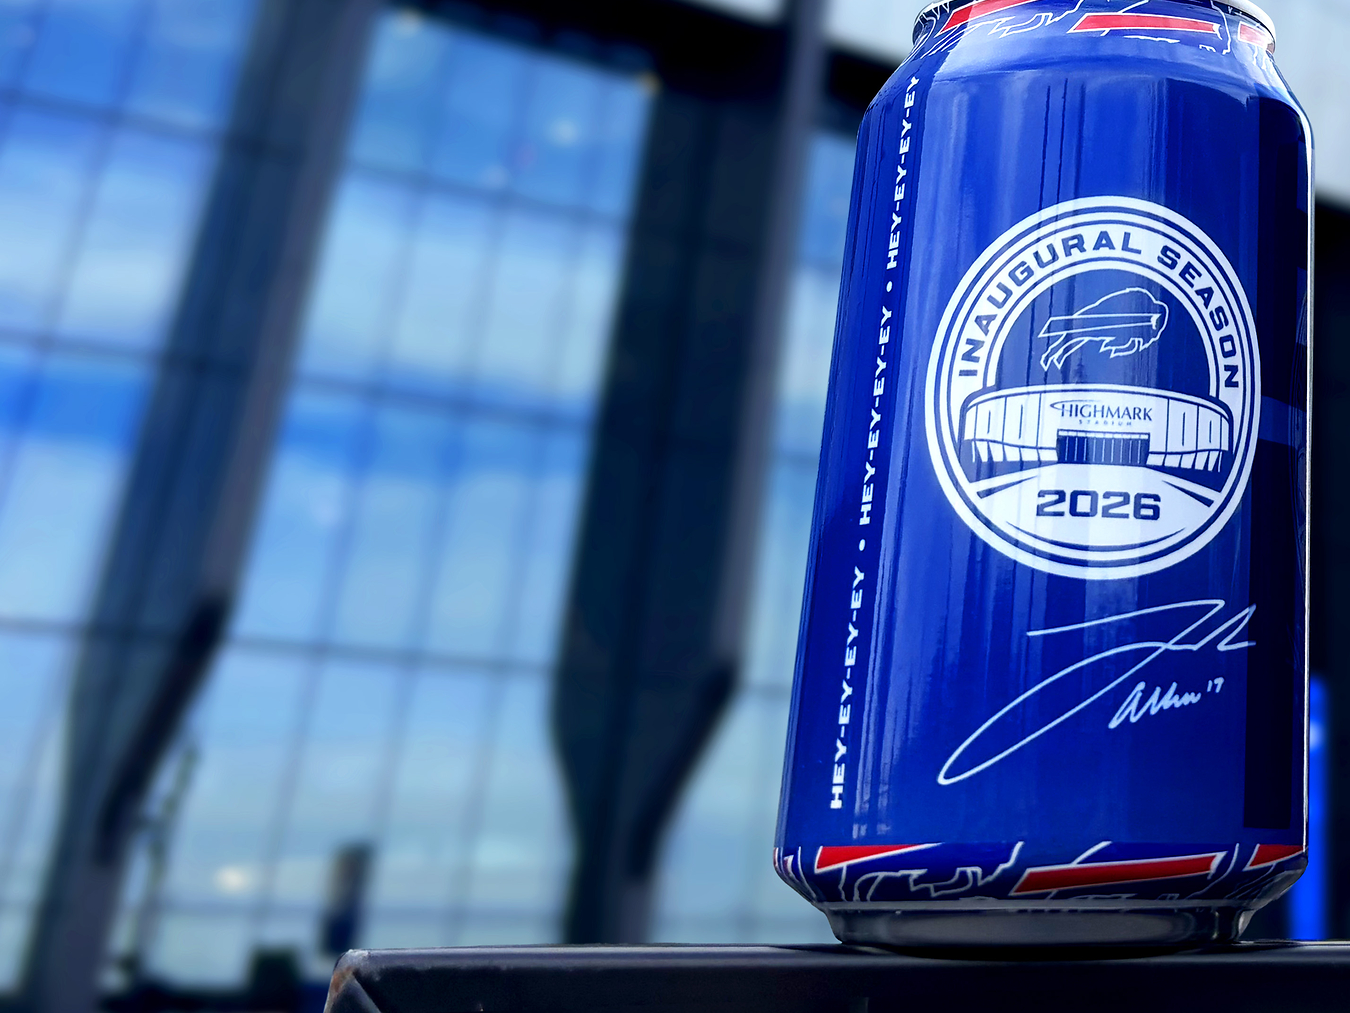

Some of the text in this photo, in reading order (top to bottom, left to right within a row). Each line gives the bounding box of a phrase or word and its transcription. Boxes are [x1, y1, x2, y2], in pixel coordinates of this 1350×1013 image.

[958, 229, 1240, 389] INAUGURAL SEASON
[830, 76, 920, 809] HEY-EY-EY-EY HEY-EY-EY-EY HEY-EY-EY-EY
[1060, 403, 1153, 422] HIGHMARK
[1035, 489, 1162, 520] 2026
